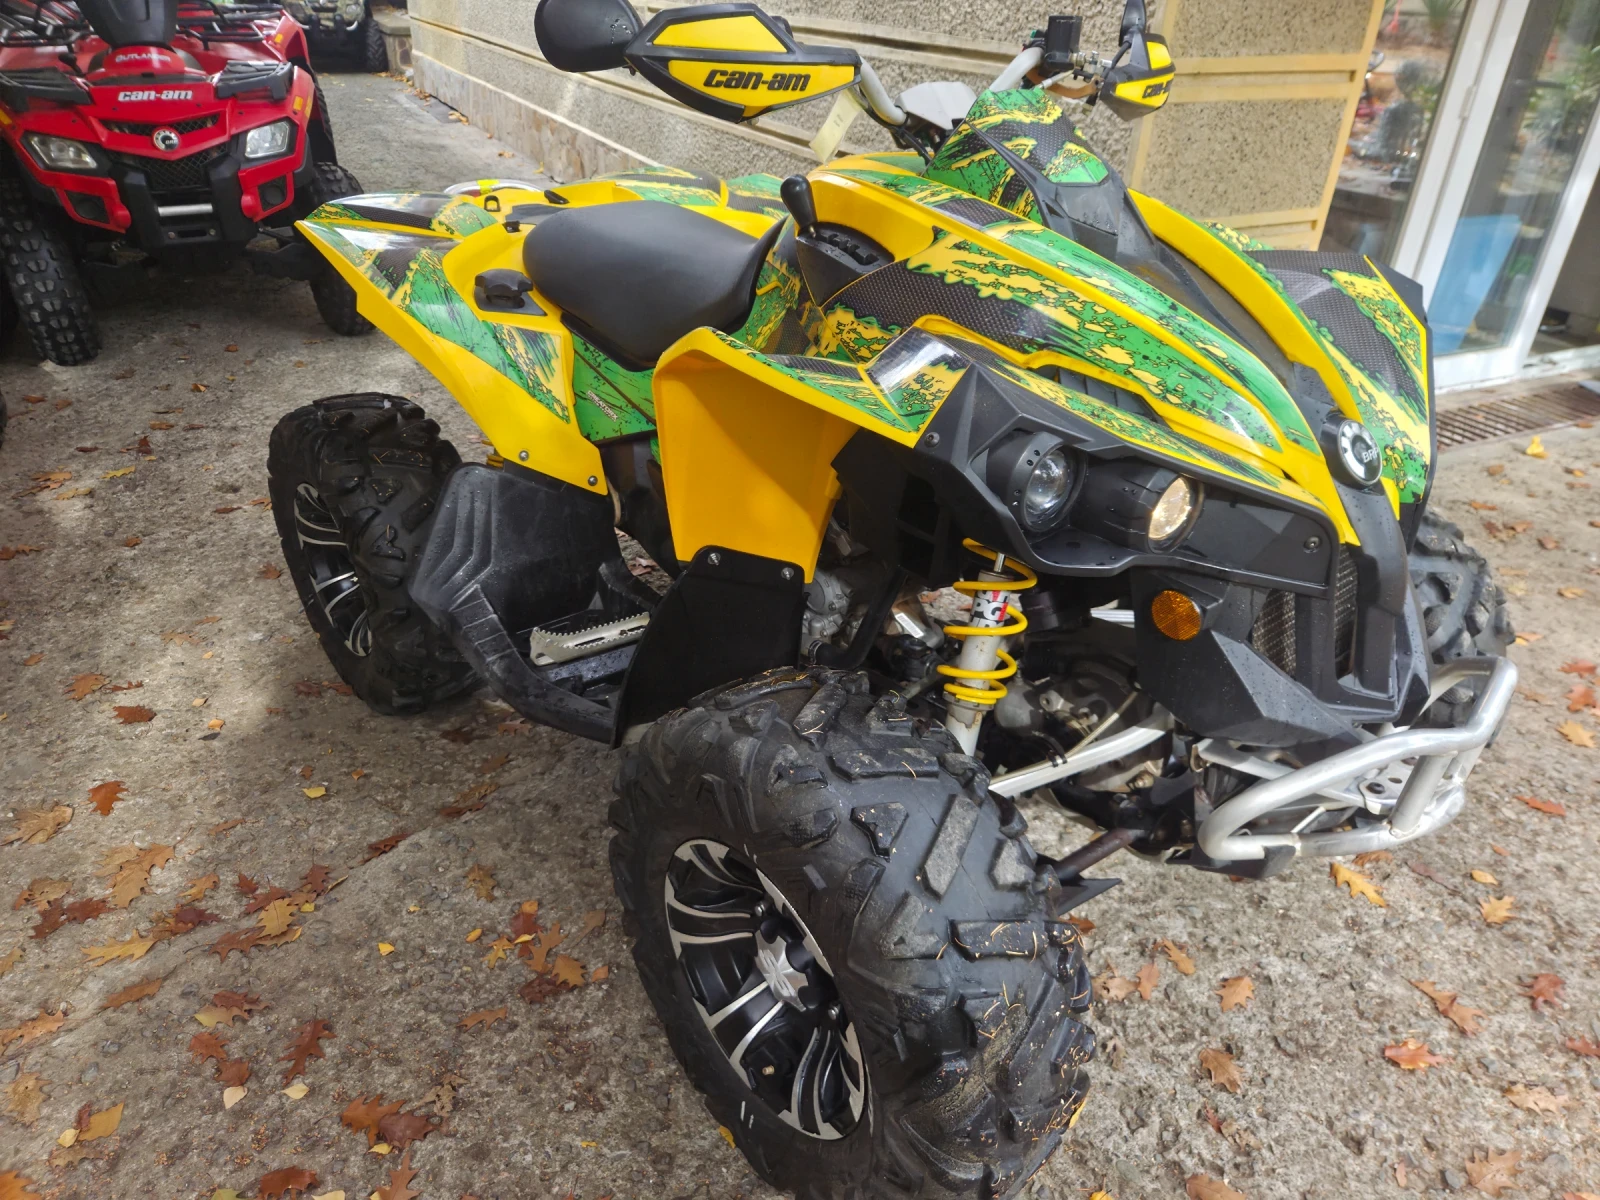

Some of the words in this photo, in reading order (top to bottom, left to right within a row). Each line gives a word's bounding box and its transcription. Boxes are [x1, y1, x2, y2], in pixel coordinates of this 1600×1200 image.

[703, 69, 811, 92] can-am
[118, 90, 193, 102] can-am
[1362, 447, 1380, 463] BRP
